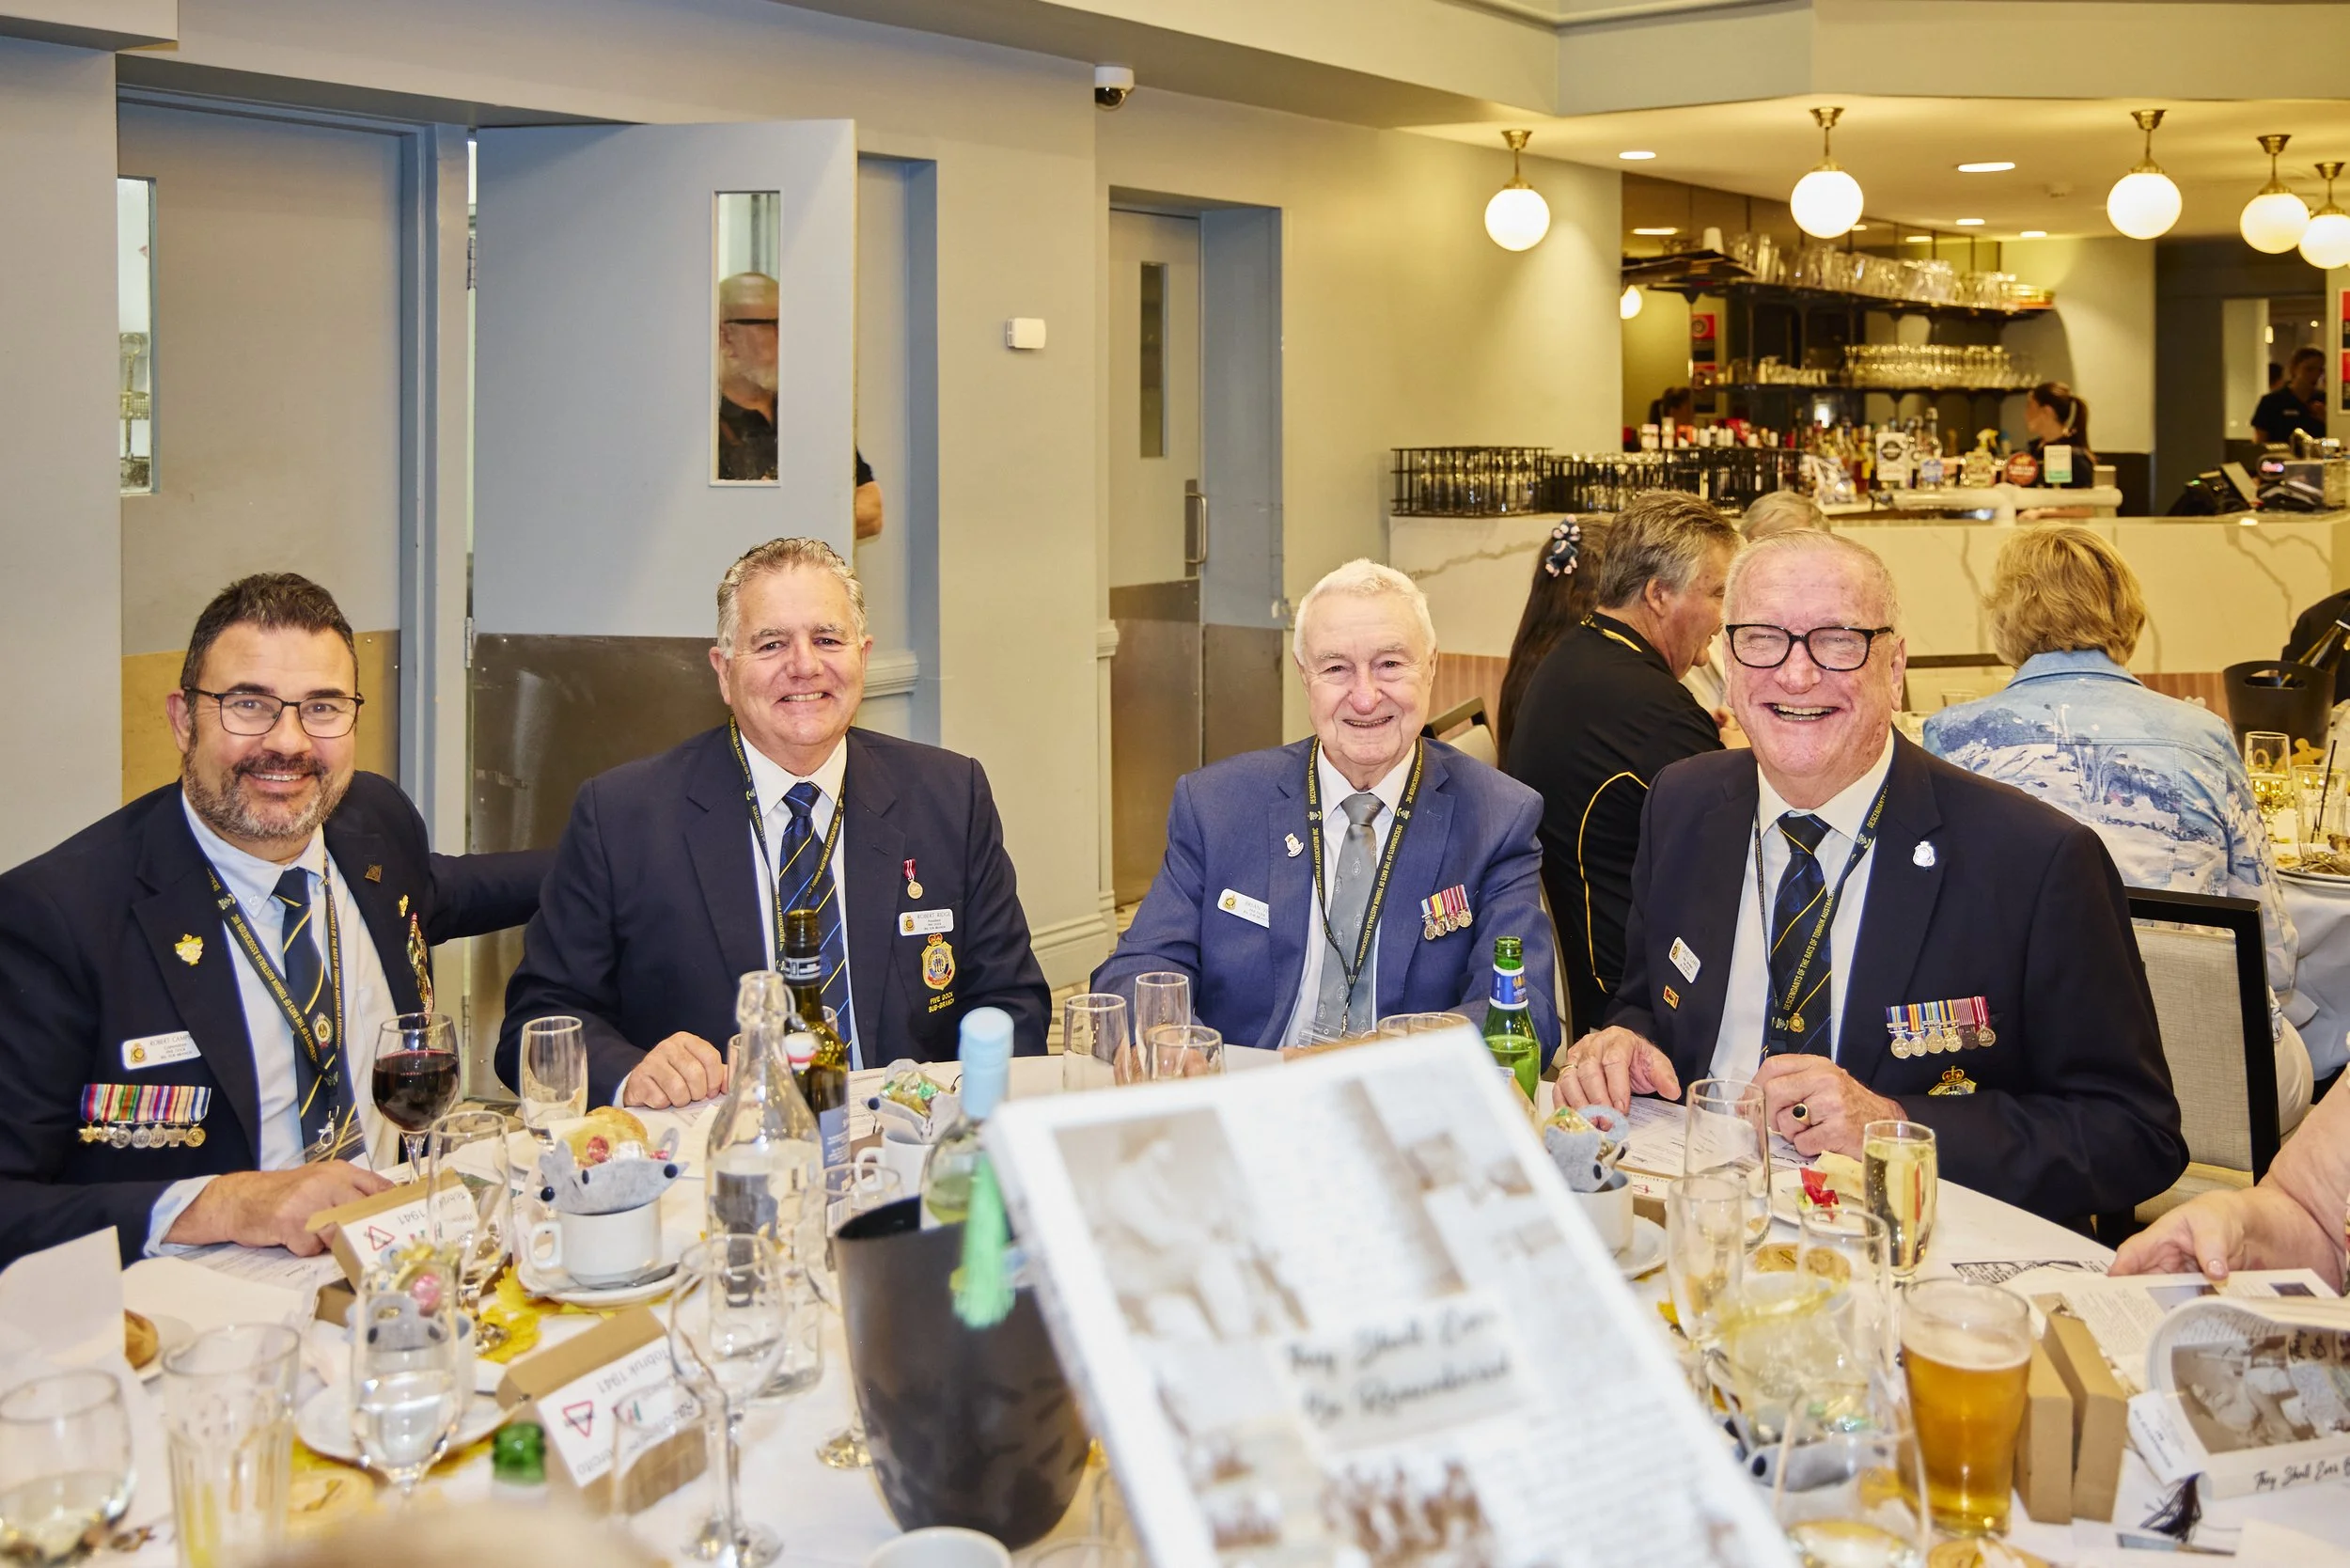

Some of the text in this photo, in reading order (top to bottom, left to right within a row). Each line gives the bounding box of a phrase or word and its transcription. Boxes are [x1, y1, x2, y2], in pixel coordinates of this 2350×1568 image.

[818, 848, 830, 871] AUSTRALIA
[825, 823, 838, 849] ASSOCIATION
[1387, 823, 1402, 855] DESCENDANTS
[1379, 869, 1388, 881] RATS
[1371, 886, 1383, 905] TOBRUK
[229, 912, 243, 925] INC
[1365, 903, 1377, 929] AUSTRALIA
[236, 921, 260, 956] ASSOCIATION
[1811, 917, 1825, 939] TOBRUK
[1357, 928, 1371, 958] ASSOCIATION
[1803, 945, 1815, 959] RATS
[1809, 937, 1818, 947] OF
[254, 952, 276, 981] AUSTRALIA
[1796, 966, 1805, 976] OF
[1799, 957, 1810, 968] THE
[282, 996, 292, 1007] OF
[1782, 974, 1803, 1011] DESCENDANTS
[399, 1209, 427, 1225] 1941
[596, 1372, 628, 1394] 1941
[2254, 1470, 2277, 1491] They
[2281, 1462, 2311, 1487] Shall
[2314, 1460, 2339, 1482] Ever
